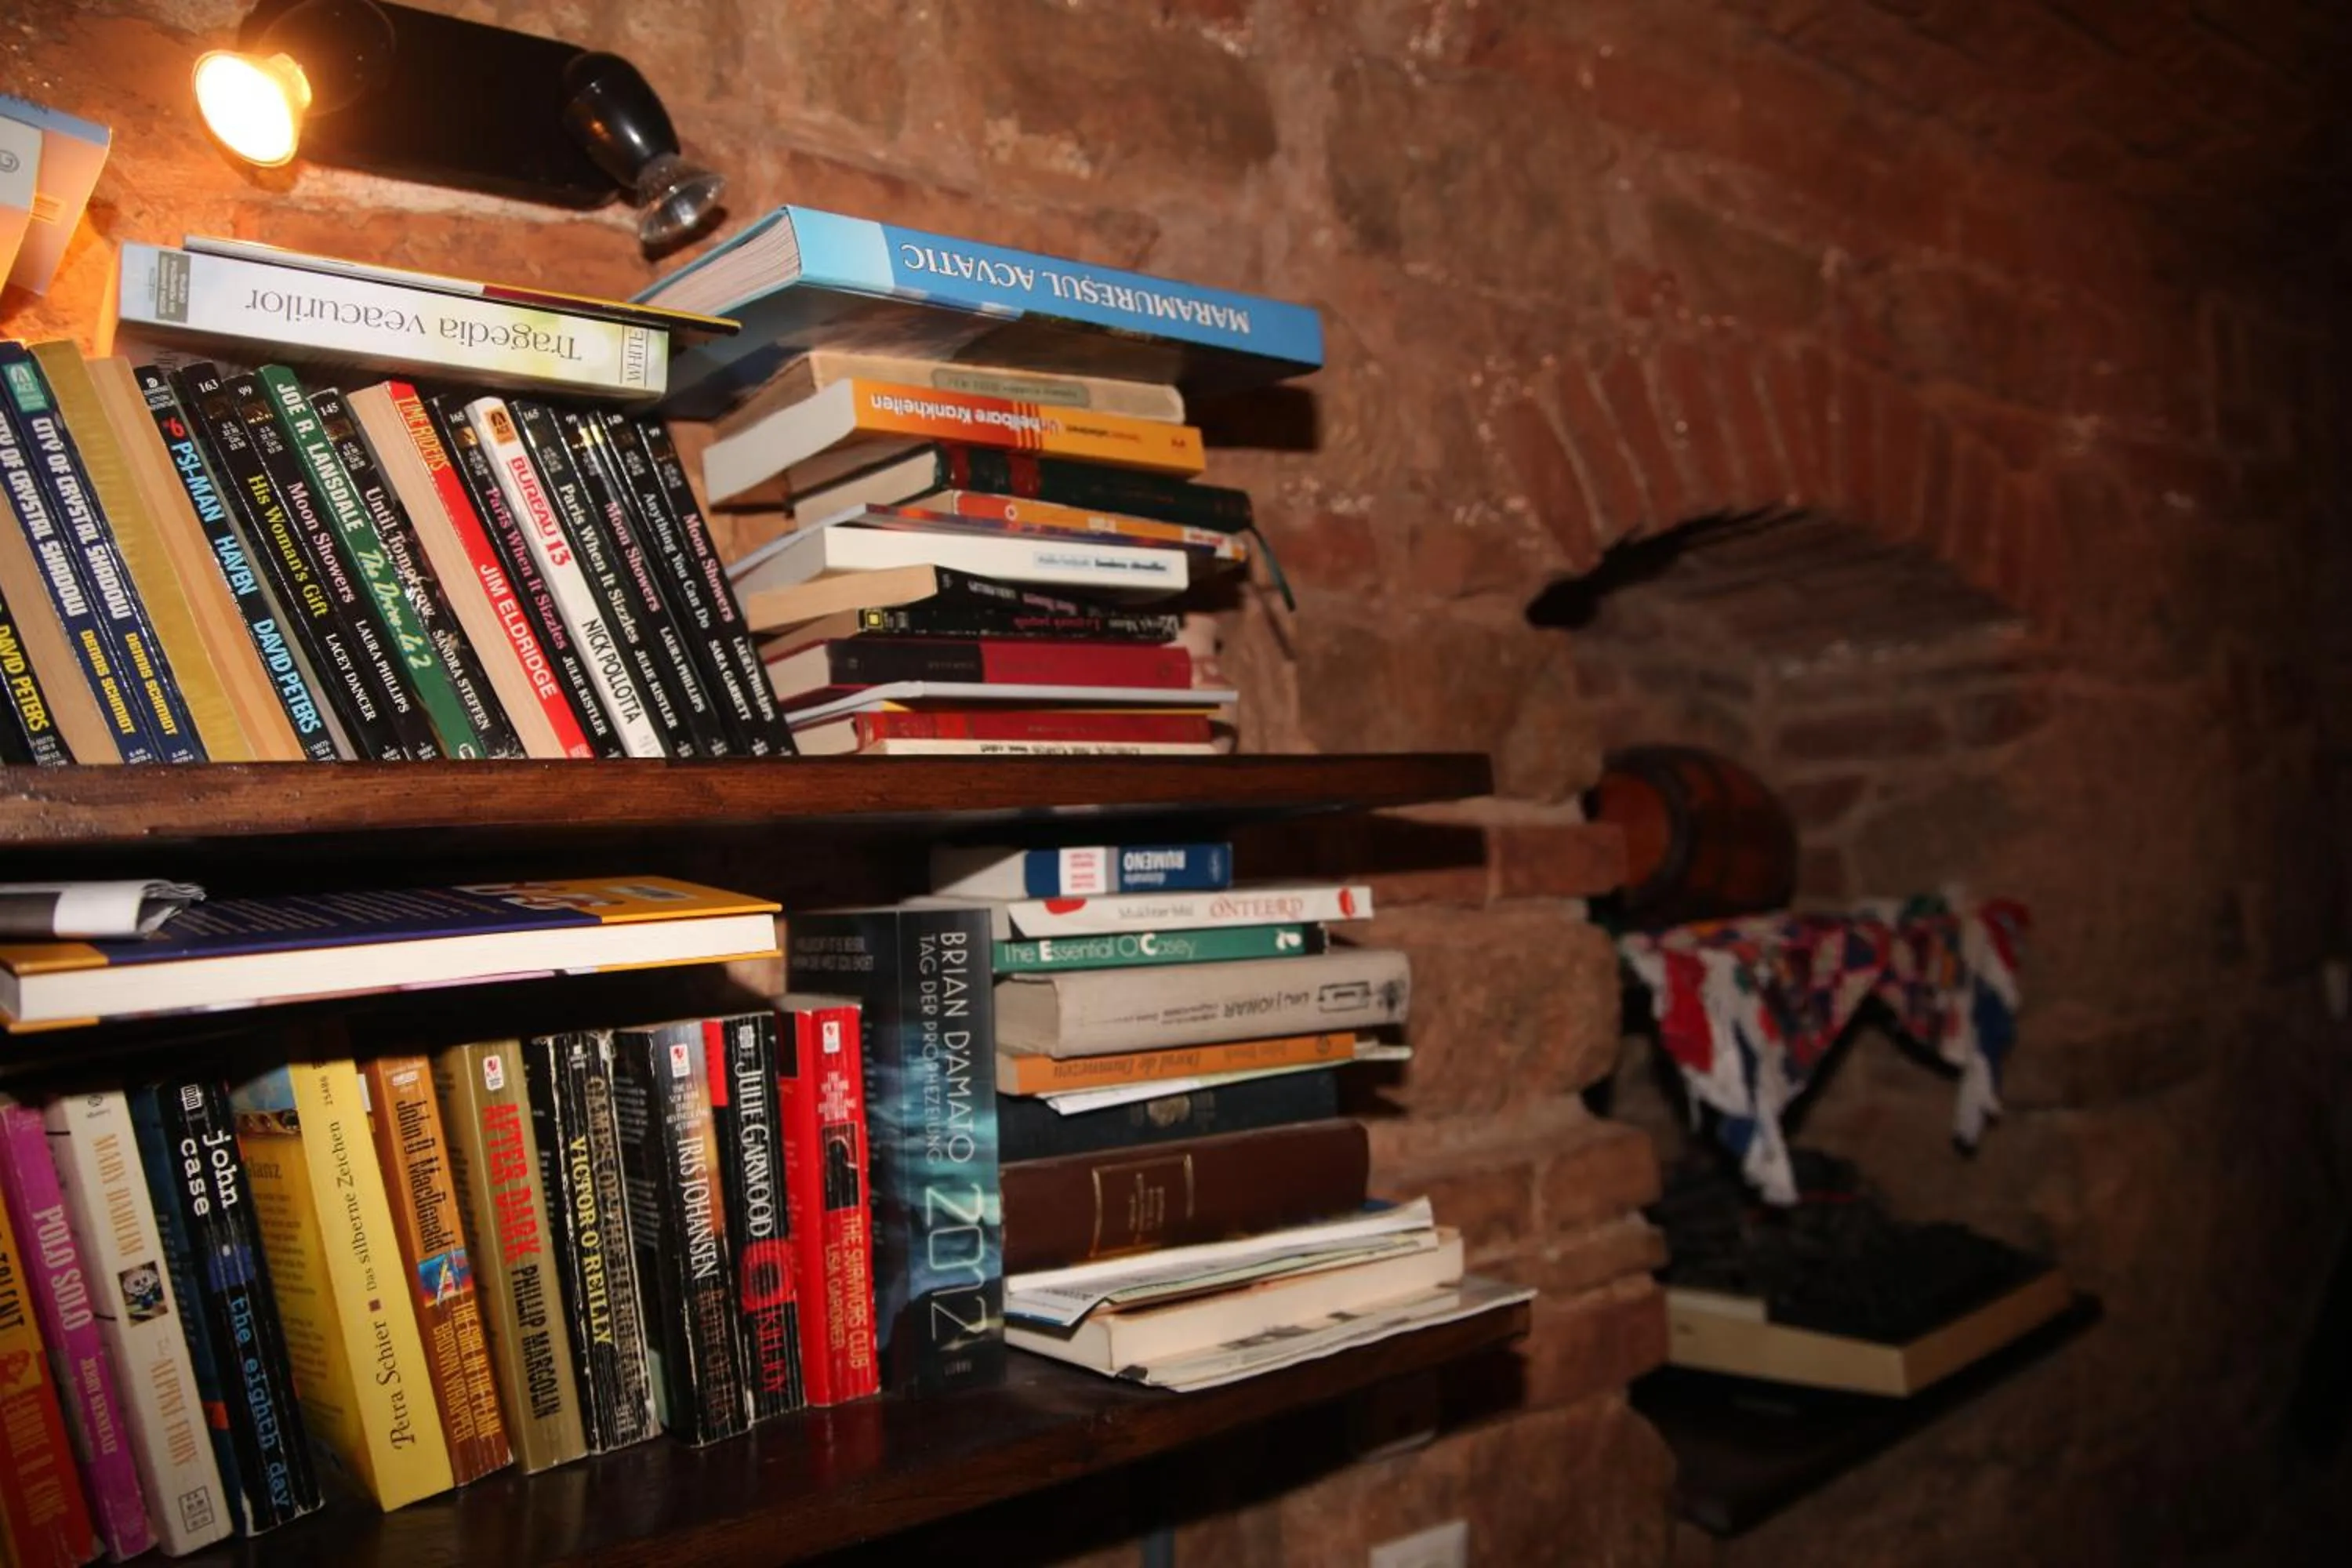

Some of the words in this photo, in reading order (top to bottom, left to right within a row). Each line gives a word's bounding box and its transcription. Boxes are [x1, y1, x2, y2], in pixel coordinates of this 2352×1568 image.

[900, 243, 1036, 292] ACVATIC
[247, 289, 426, 335] veacurilor
[438, 317, 583, 362] Tragedia
[198, 379, 220, 393] 163
[627, 328, 647, 381] WHITE
[238, 385, 253, 396] 99
[319, 402, 339, 416] 145
[871, 394, 972, 424] Krankheiten
[1, 448, 25, 469] OF
[32, 417, 64, 452] CITY
[47, 455, 71, 475] OF
[277, 383, 307, 416] JOE
[295, 418, 314, 439] R.
[307, 442, 365, 533] LANSDALE
[8, 470, 53, 541] CRYSTAL
[56, 475, 100, 544] CRYSTAL
[171, 441, 226, 523] PSI-MAN
[214, 535, 258, 597] HAVEN
[365, 486, 397, 530] Until
[485, 486, 513, 529] Paris
[509, 456, 559, 538] BUREAU
[545, 539, 572, 567] 13
[247, 474, 270, 506] His
[264, 502, 307, 582] Woman's
[302, 583, 329, 618] Gift
[287, 481, 320, 532] Moon
[312, 531, 356, 604] Showers
[506, 529, 534, 578] When
[559, 483, 584, 526] Paris
[580, 524, 607, 576] When
[600, 572, 616, 588] It
[608, 588, 640, 644] Sizzles
[604, 501, 631, 546] Moon
[625, 545, 662, 613] Showers
[643, 493, 677, 554] Anything
[672, 552, 688, 579] You
[683, 579, 699, 608] Can
[695, 606, 710, 630] Do
[683, 513, 706, 557] Moon
[702, 557, 735, 623] Showers
[39, 540, 89, 617] SHADOW
[85, 545, 132, 619] SHADOW
[358, 549, 385, 579] The
[408, 653, 432, 670] 2
[527, 577, 542, 593] It
[0, 625, 25, 674] DAVID
[480, 564, 505, 598] JIM
[498, 597, 558, 701] ELDRIDGE
[533, 591, 568, 650] Sizzles
[708, 639, 728, 671] SARA
[80, 630, 111, 677] DENNIS
[101, 677, 136, 735] SCHMIDT
[125, 632, 154, 679] DENNIS
[145, 679, 179, 735] SCHMIDT
[253, 618, 292, 673] DAVID
[278, 673, 321, 734] PETERS
[325, 633, 353, 671] LACEY
[345, 670, 377, 722] DANCER
[355, 619, 383, 662] LAURA
[376, 659, 410, 713] PHILLIPS
[433, 630, 464, 679] SANDRA
[457, 677, 492, 731] STEFFEN
[581, 617, 611, 660] NICK
[600, 654, 641, 725] POLLOTTA
[634, 649, 655, 682] JULIE
[649, 680, 679, 729] KISTLER
[659, 626, 682, 668] LAURA
[677, 664, 705, 713] PHILLIPS
[731, 636, 753, 675] LAURA
[11, 675, 50, 732] PETERS
[562, 655, 585, 689] JULIE
[578, 687, 608, 736] KISTLER
[1123, 851, 1186, 872] RUMENO
[920, 936, 936, 975] TAG
[941, 931, 969, 1017] BRIAN
[1004, 943, 1036, 963] The
[1040, 936, 1115, 962] Essential
[1118, 932, 1198, 957] O'Casey
[920, 982, 938, 1014] DER
[397, 1099, 430, 1141] John
[735, 1062, 764, 1122] JULIE
[923, 1022, 941, 1164] PROPHEZEIUNG
[944, 1030, 975, 1163] D'AMATO
[93, 1134, 126, 1184] MARY
[180, 1138, 210, 1217] case
[202, 1130, 238, 1209] john
[329, 1121, 354, 1189] Zeichen
[482, 1103, 528, 1186] AFTER
[677, 1137, 706, 1176] IRIS
[408, 1157, 456, 1253] MacDonald
[570, 1135, 597, 1227] VICTOR
[741, 1123, 773, 1238] GARWOOD
[32, 1204, 75, 1269] POLO
[343, 1192, 371, 1265] silberne
[495, 1185, 542, 1265] DARK
[679, 1178, 719, 1281] JOHANSEN
[842, 1214, 862, 1251] THE
[365, 1268, 377, 1291] Das
[825, 1243, 840, 1277] LISA
[844, 1249, 869, 1329] SURVIVORS
[926, 1183, 986, 1341] 2012
[50, 1268, 93, 1331] SOLO
[452, 1299, 477, 1326] THE
[512, 1265, 547, 1329] PHILLIP
[828, 1278, 845, 1351] GARDNER
[374, 1321, 401, 1385] Schier
[434, 1320, 461, 1377] BROWN
[463, 1354, 488, 1371] IN
[466, 1368, 492, 1397] THE
[521, 1331, 561, 1421] MARGOLIN
[848, 1330, 869, 1369] CLUB
[230, 1296, 252, 1344] the
[245, 1357, 280, 1448] eighth
[268, 1462, 290, 1506] day
[390, 1391, 415, 1449] Petra
[445, 1370, 474, 1443] WRAPPER
